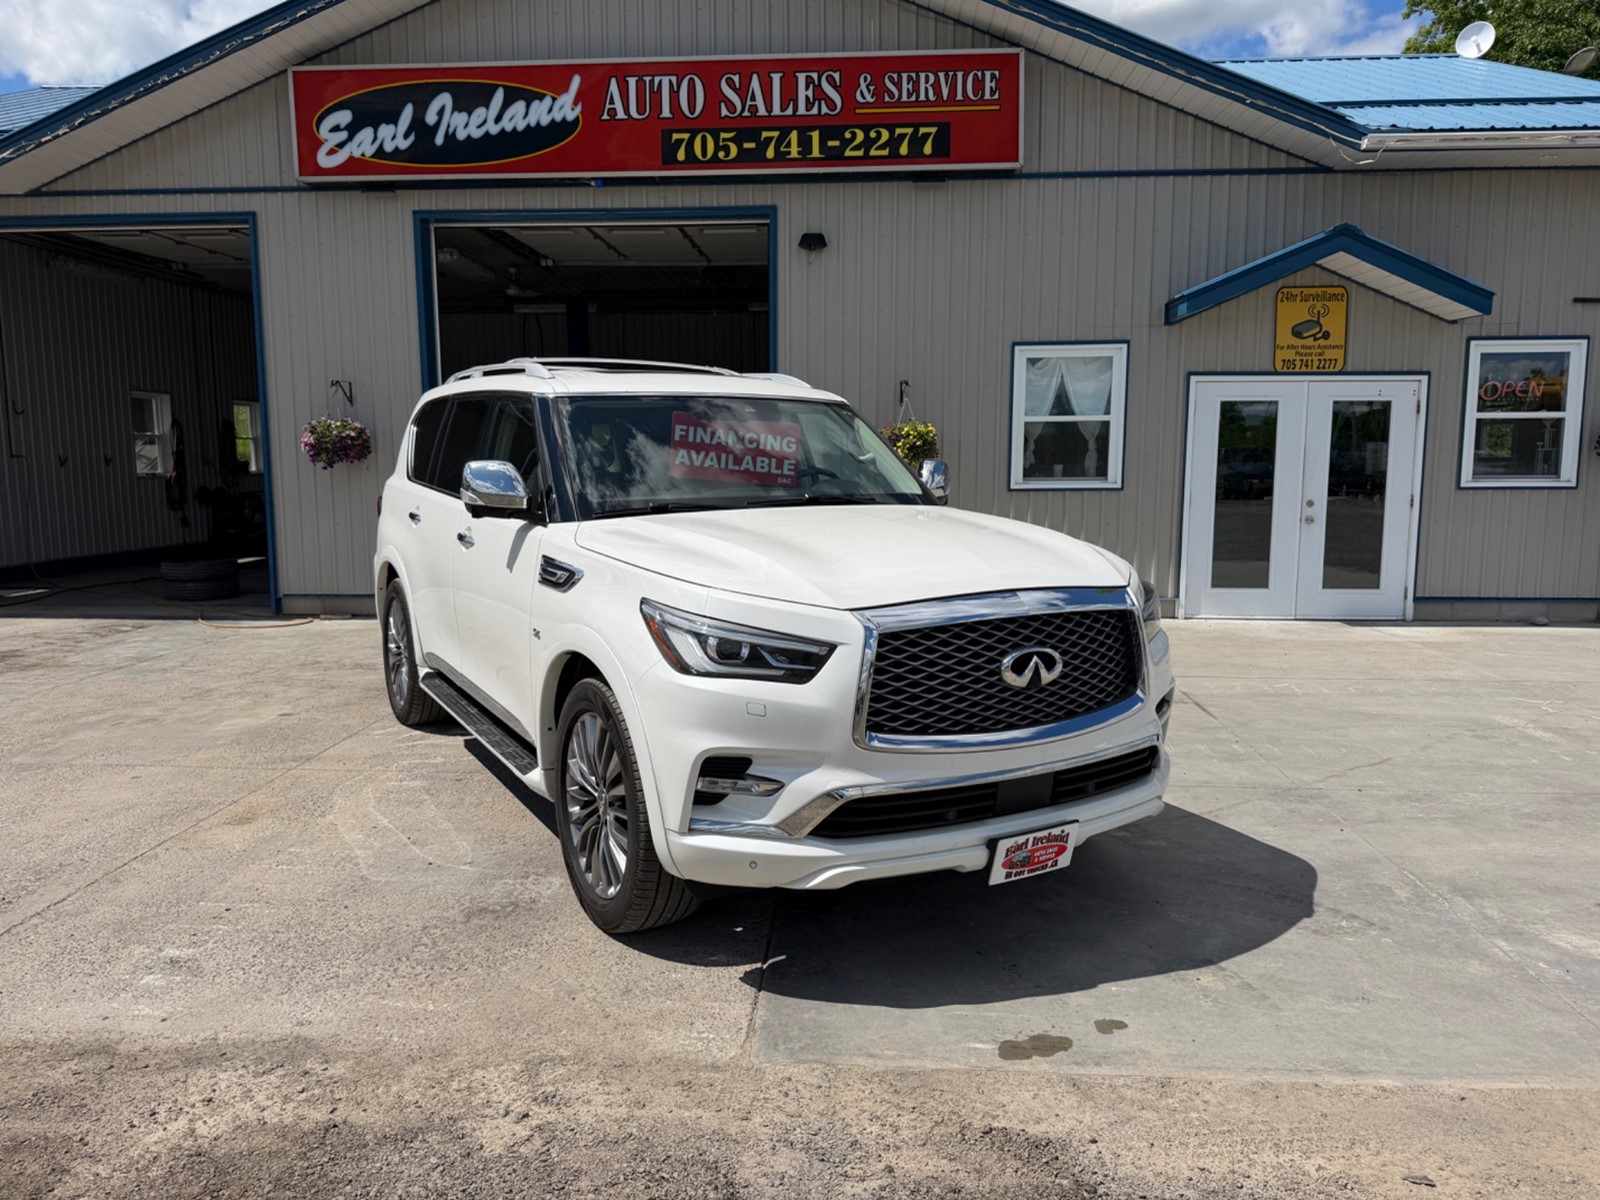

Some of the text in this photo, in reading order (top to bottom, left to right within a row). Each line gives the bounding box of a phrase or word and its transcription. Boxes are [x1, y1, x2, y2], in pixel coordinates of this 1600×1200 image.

[600, 69, 1001, 121] AUTO SALES & SERVICE
[316, 73, 583, 169] Earl Ireland
[670, 126, 939, 162] 705-741-2277
[1280, 290, 1345, 303] 24hr Surveillance
[1280, 358, 1338, 370] 705 741 2277
[1480, 380, 1544, 401] OPEN
[673, 424, 797, 453] FINANCING
[674, 449, 796, 476] AVAILABLE
[1005, 832, 1070, 858] Earl Ireland
